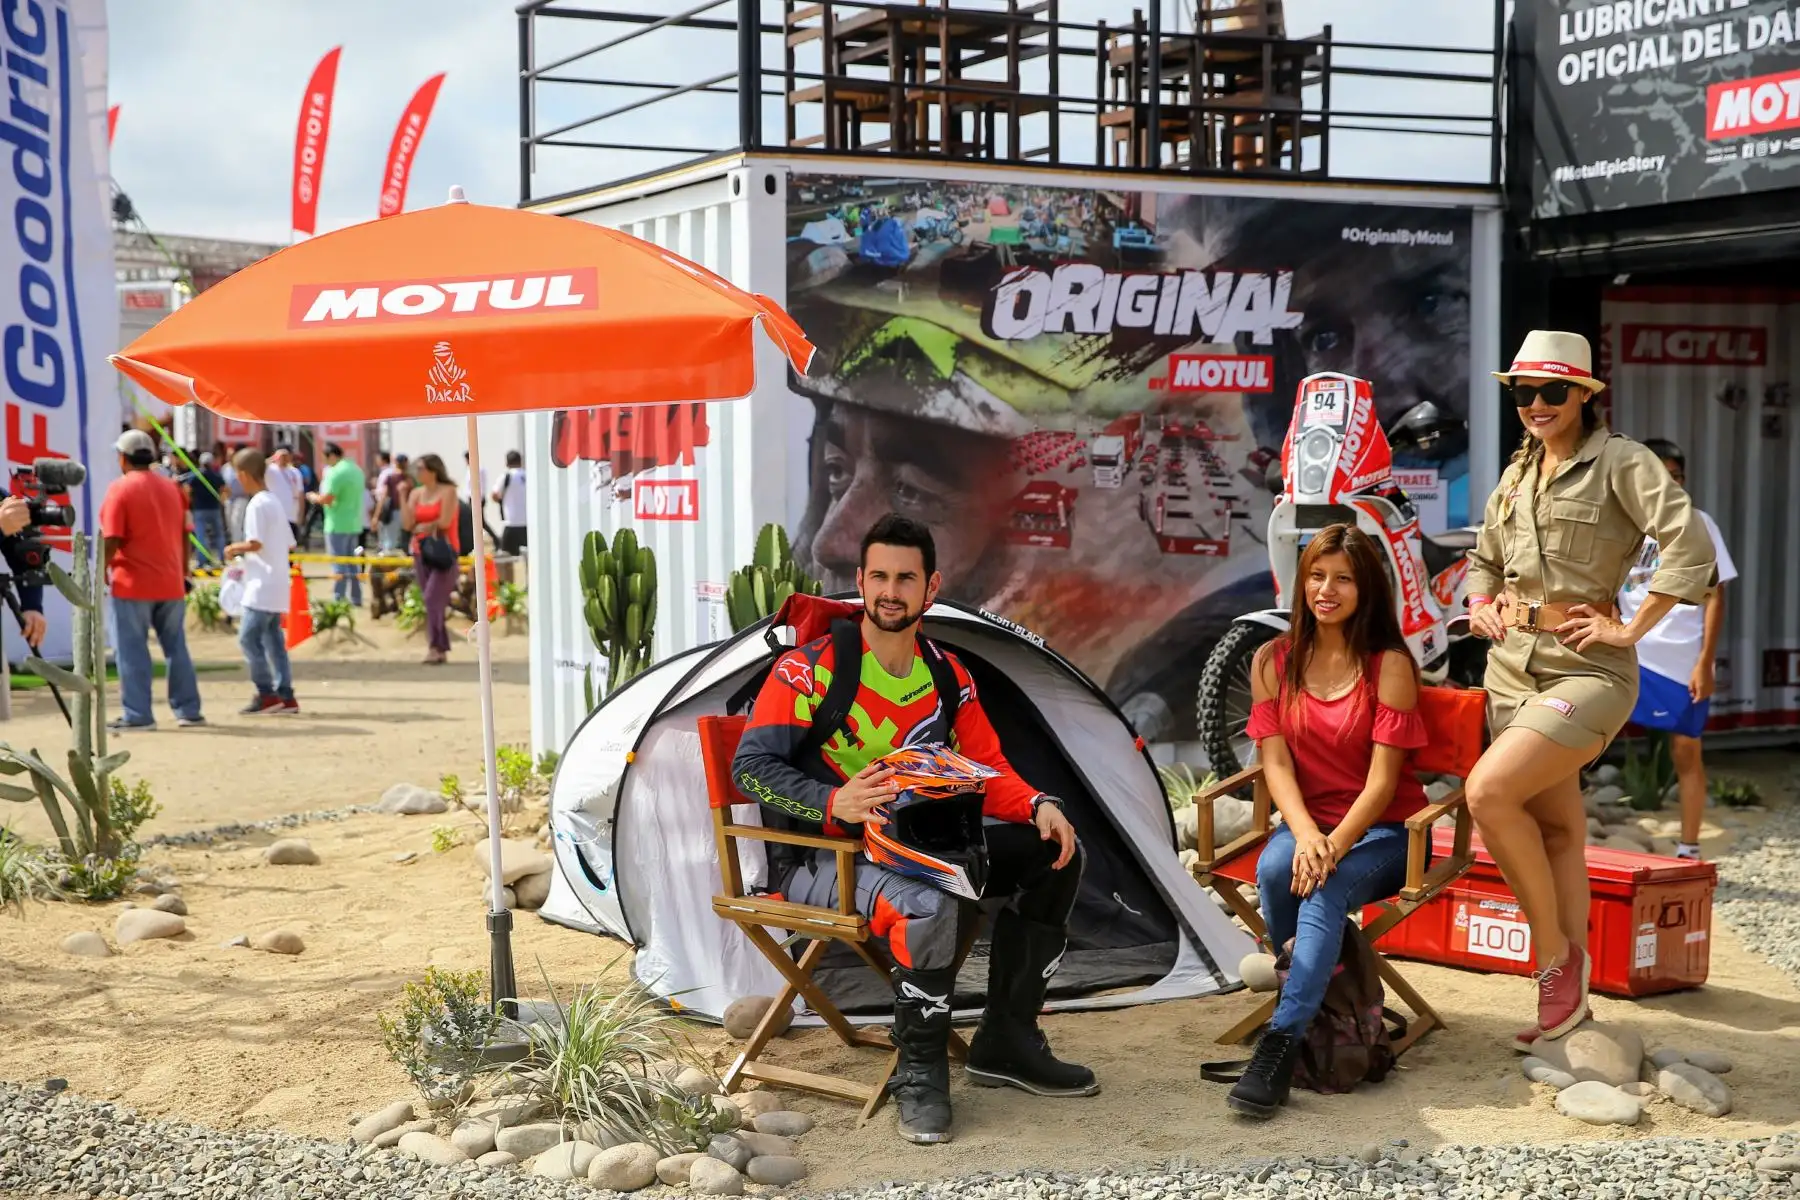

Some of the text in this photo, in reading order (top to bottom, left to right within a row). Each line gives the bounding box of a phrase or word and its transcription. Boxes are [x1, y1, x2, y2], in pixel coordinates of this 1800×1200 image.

[1559, 0, 1749, 46] LUBRICAN
[1557, 7, 1800, 86] OFICIAL DEL DA
[1554, 154, 1666, 182] #MotulEpicStory
[1341, 226, 1454, 246] #OriginalByMotul
[301, 274, 585, 322] MOTUL
[990, 263, 1305, 345] ORIGINAL
[1173, 359, 1269, 388] MOTUL
[1542, 362, 1570, 373] MOTUL
[425, 382, 477, 404] DAKAR
[1314, 391, 1337, 411] 94
[1337, 396, 1373, 477] MOTUL
[1393, 538, 1425, 623] MOTUL
[1471, 922, 1526, 954] 100
[1636, 942, 1655, 960] 100
